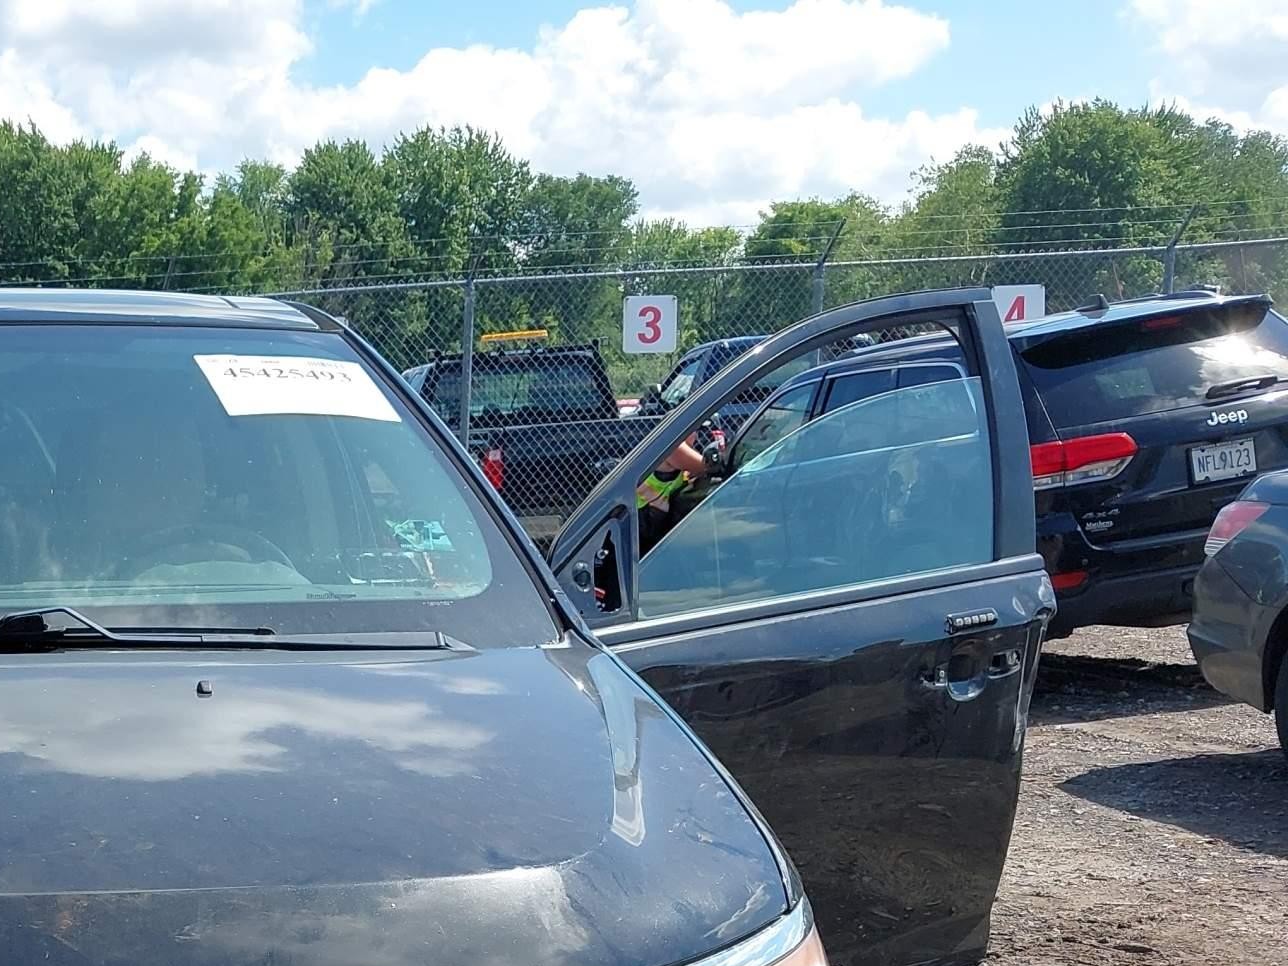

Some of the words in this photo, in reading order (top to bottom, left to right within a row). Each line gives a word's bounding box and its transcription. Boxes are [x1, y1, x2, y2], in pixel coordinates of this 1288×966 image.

[1003, 295, 1025, 322] 4
[637, 306, 662, 344] 3
[223, 367, 352, 384] 45425493
[1207, 408, 1248, 426] Jeep
[1197, 447, 1251, 474] NFL9123
